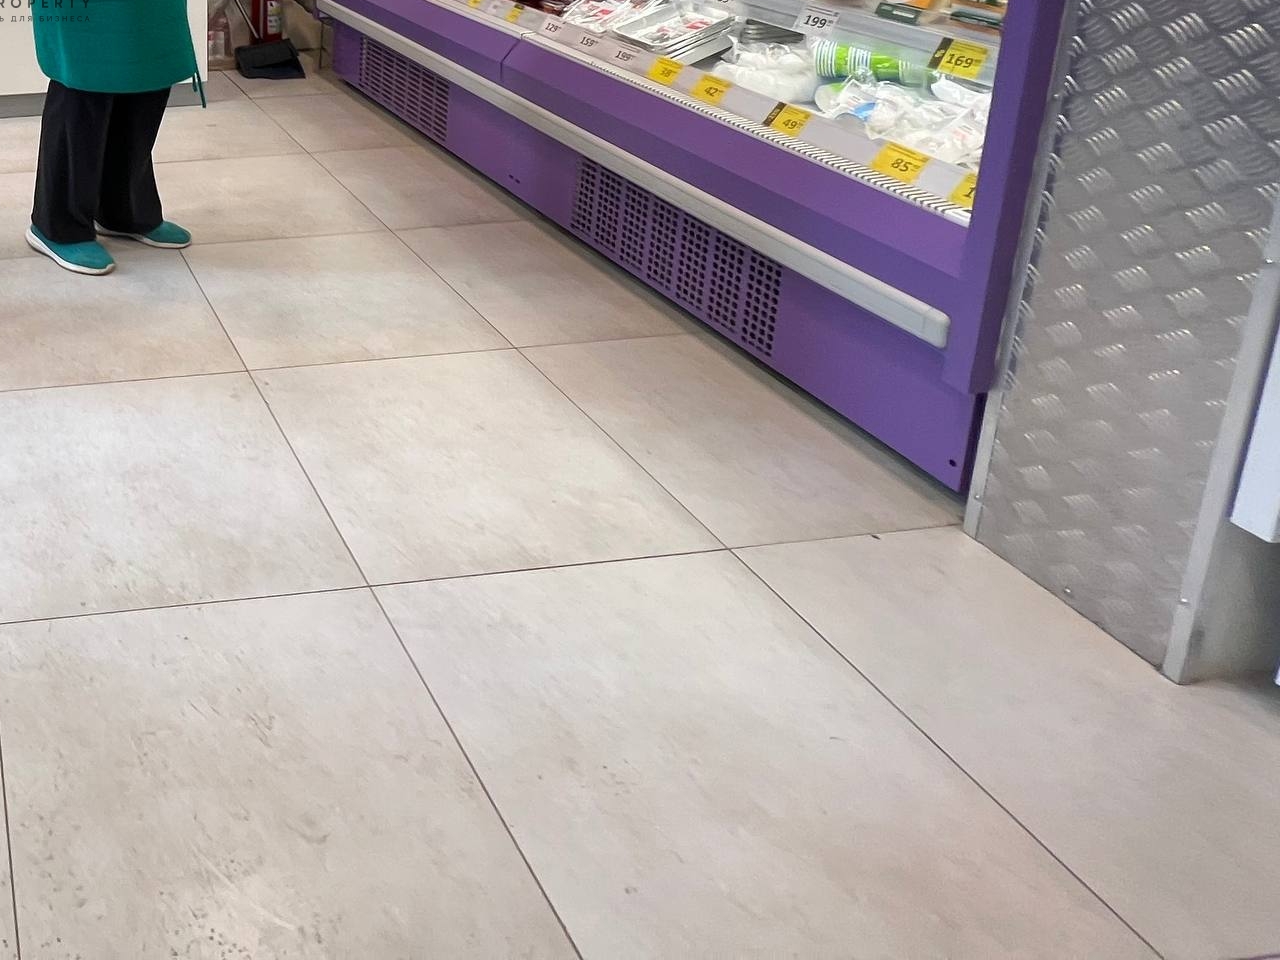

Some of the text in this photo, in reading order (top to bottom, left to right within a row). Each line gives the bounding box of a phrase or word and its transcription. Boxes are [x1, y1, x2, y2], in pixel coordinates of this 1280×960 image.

[803, 15, 827, 29] 199
[580, 36, 596, 47] 159
[946, 53, 974, 69] 169
[703, 86, 719, 97] 42
[783, 119, 798, 130] 49
[891, 157, 912, 172] 85
